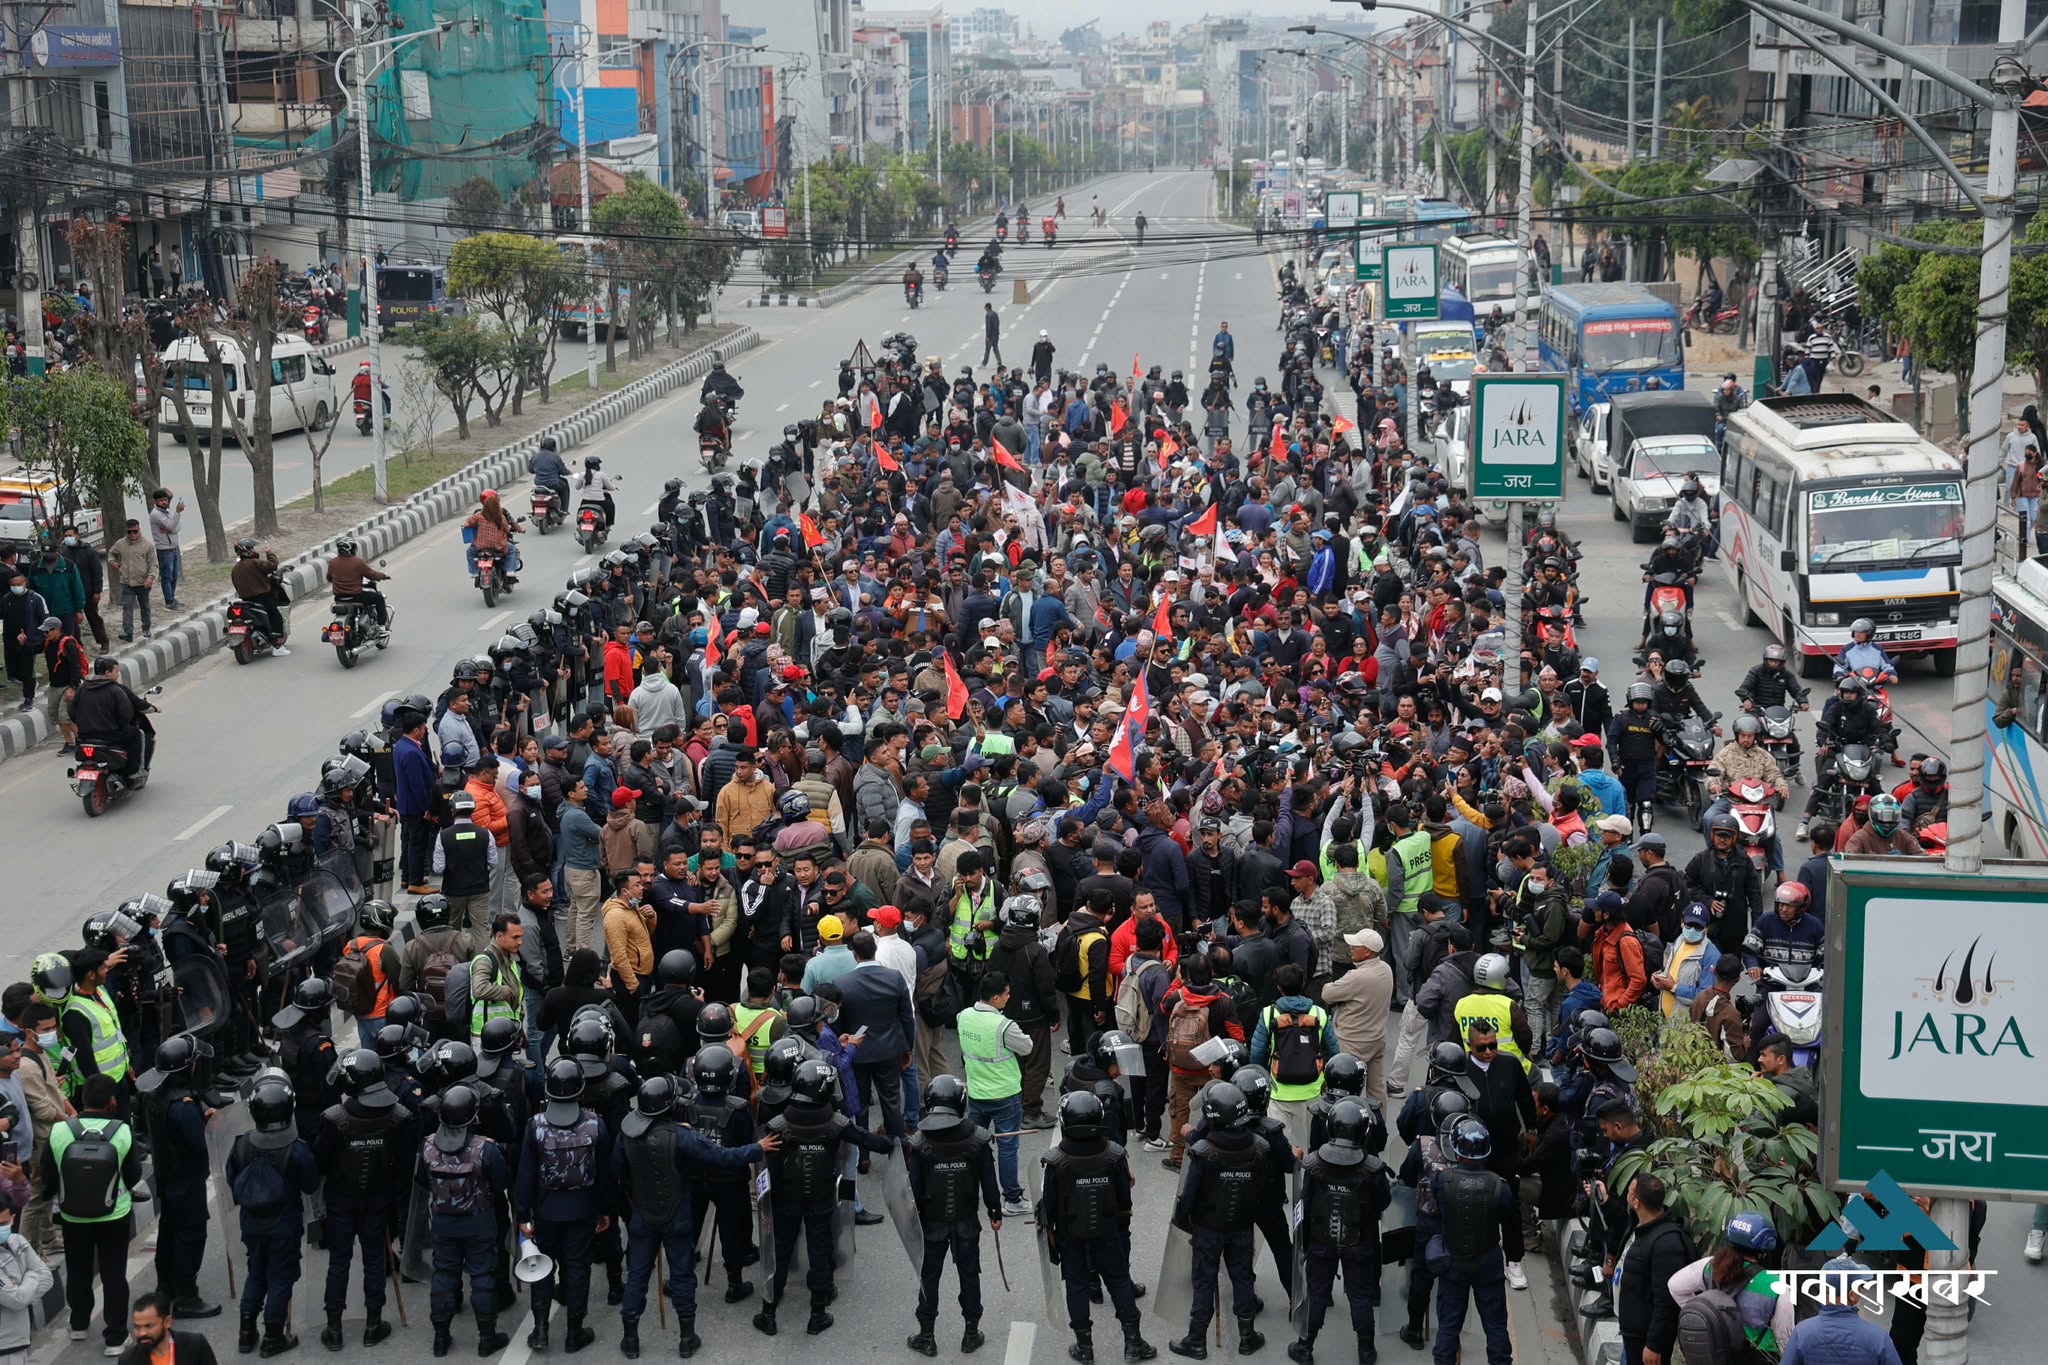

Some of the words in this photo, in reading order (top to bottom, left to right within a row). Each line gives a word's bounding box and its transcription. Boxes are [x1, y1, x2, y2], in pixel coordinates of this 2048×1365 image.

[1396, 275, 1428, 288] JARA
[390, 306, 418, 315] POLICE
[1403, 304, 1421, 313] जरा
[1492, 428, 1547, 449] JARA
[1503, 474, 1533, 489] जरा
[1830, 490, 1885, 506] Barahi
[1886, 486, 1942, 502] Ajima
[1883, 598, 1907, 606] TATA
[962, 1030, 982, 1042] PRESS
[1887, 1010, 2036, 1060] JARA
[366, 1138, 384, 1146] POLICE
[1918, 1128, 1997, 1163] जरा
[1076, 1178, 1092, 1186] NEPAL
[1092, 1176, 1109, 1185] POLICE
[1220, 1171, 1235, 1179] NEPAL
[1235, 1171, 1252, 1179] POLICE
[1731, 1219, 1752, 1233] PRESS
